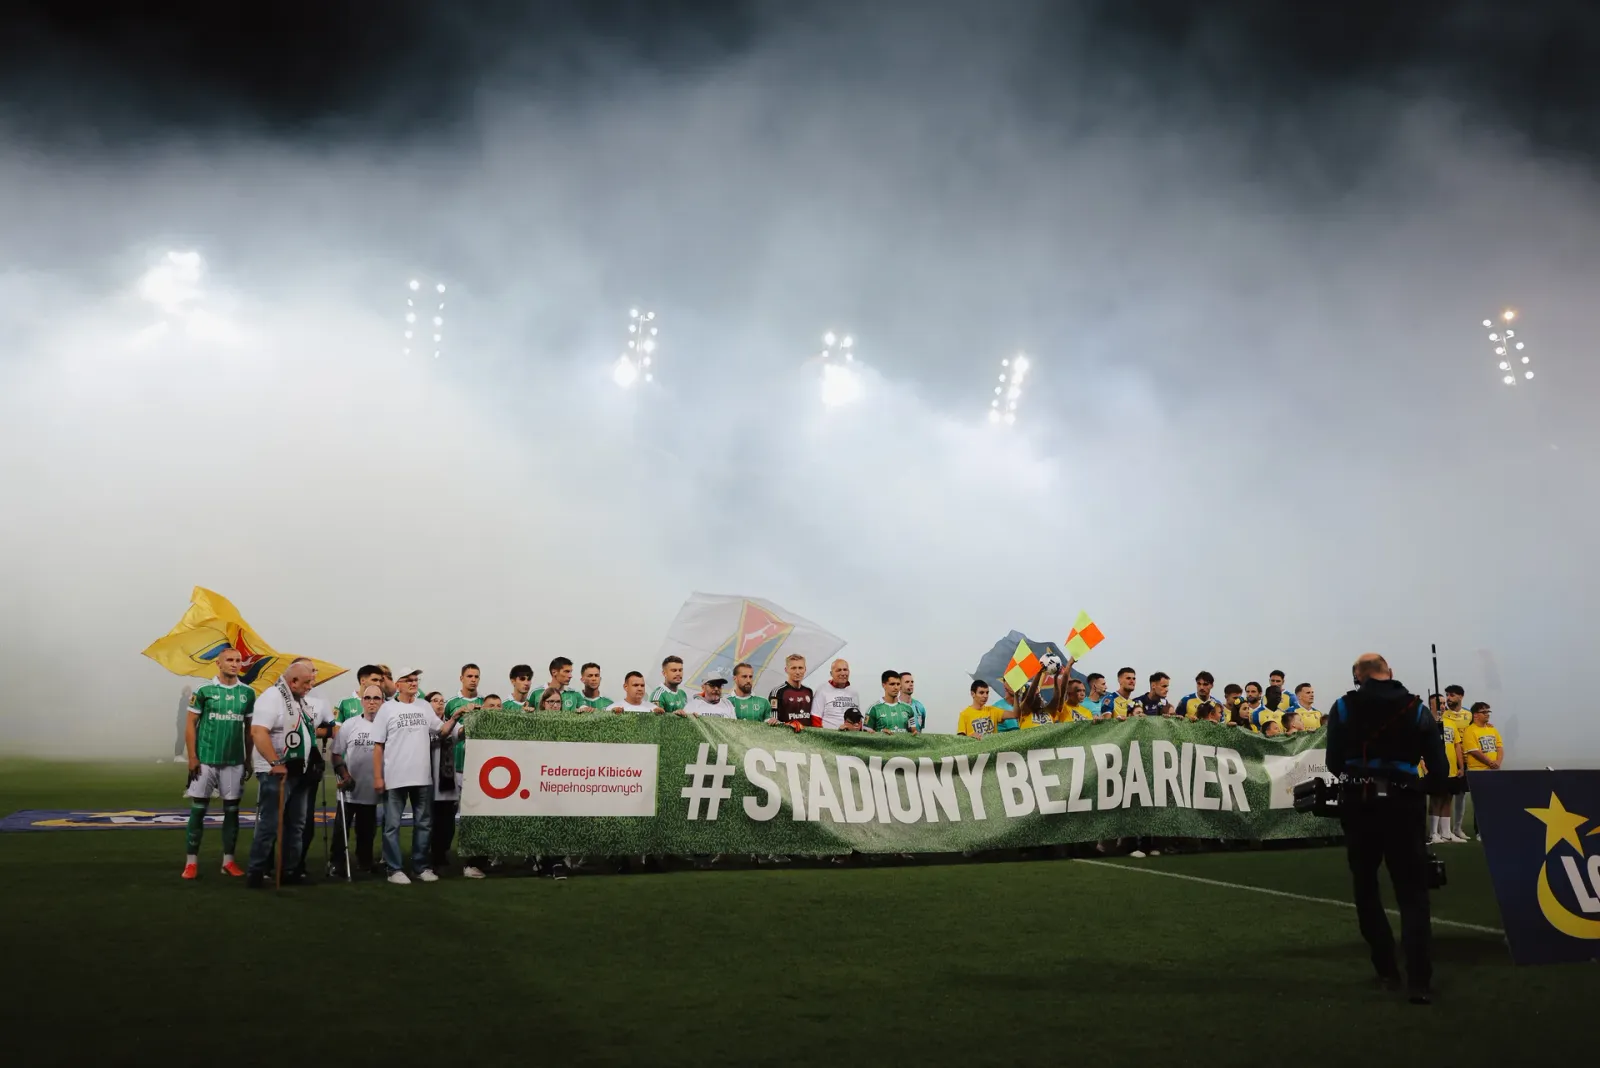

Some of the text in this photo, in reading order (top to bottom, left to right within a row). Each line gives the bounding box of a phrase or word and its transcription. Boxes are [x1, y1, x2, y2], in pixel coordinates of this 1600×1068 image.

[396, 719, 409, 729] BEZ
[290, 734, 297, 746] L
[540, 765, 643, 780] Federacja Kibiców
[540, 781, 643, 797] Niepełnosprawnych
[681, 740, 1251, 824] #STADIONY BEZ BARIER
